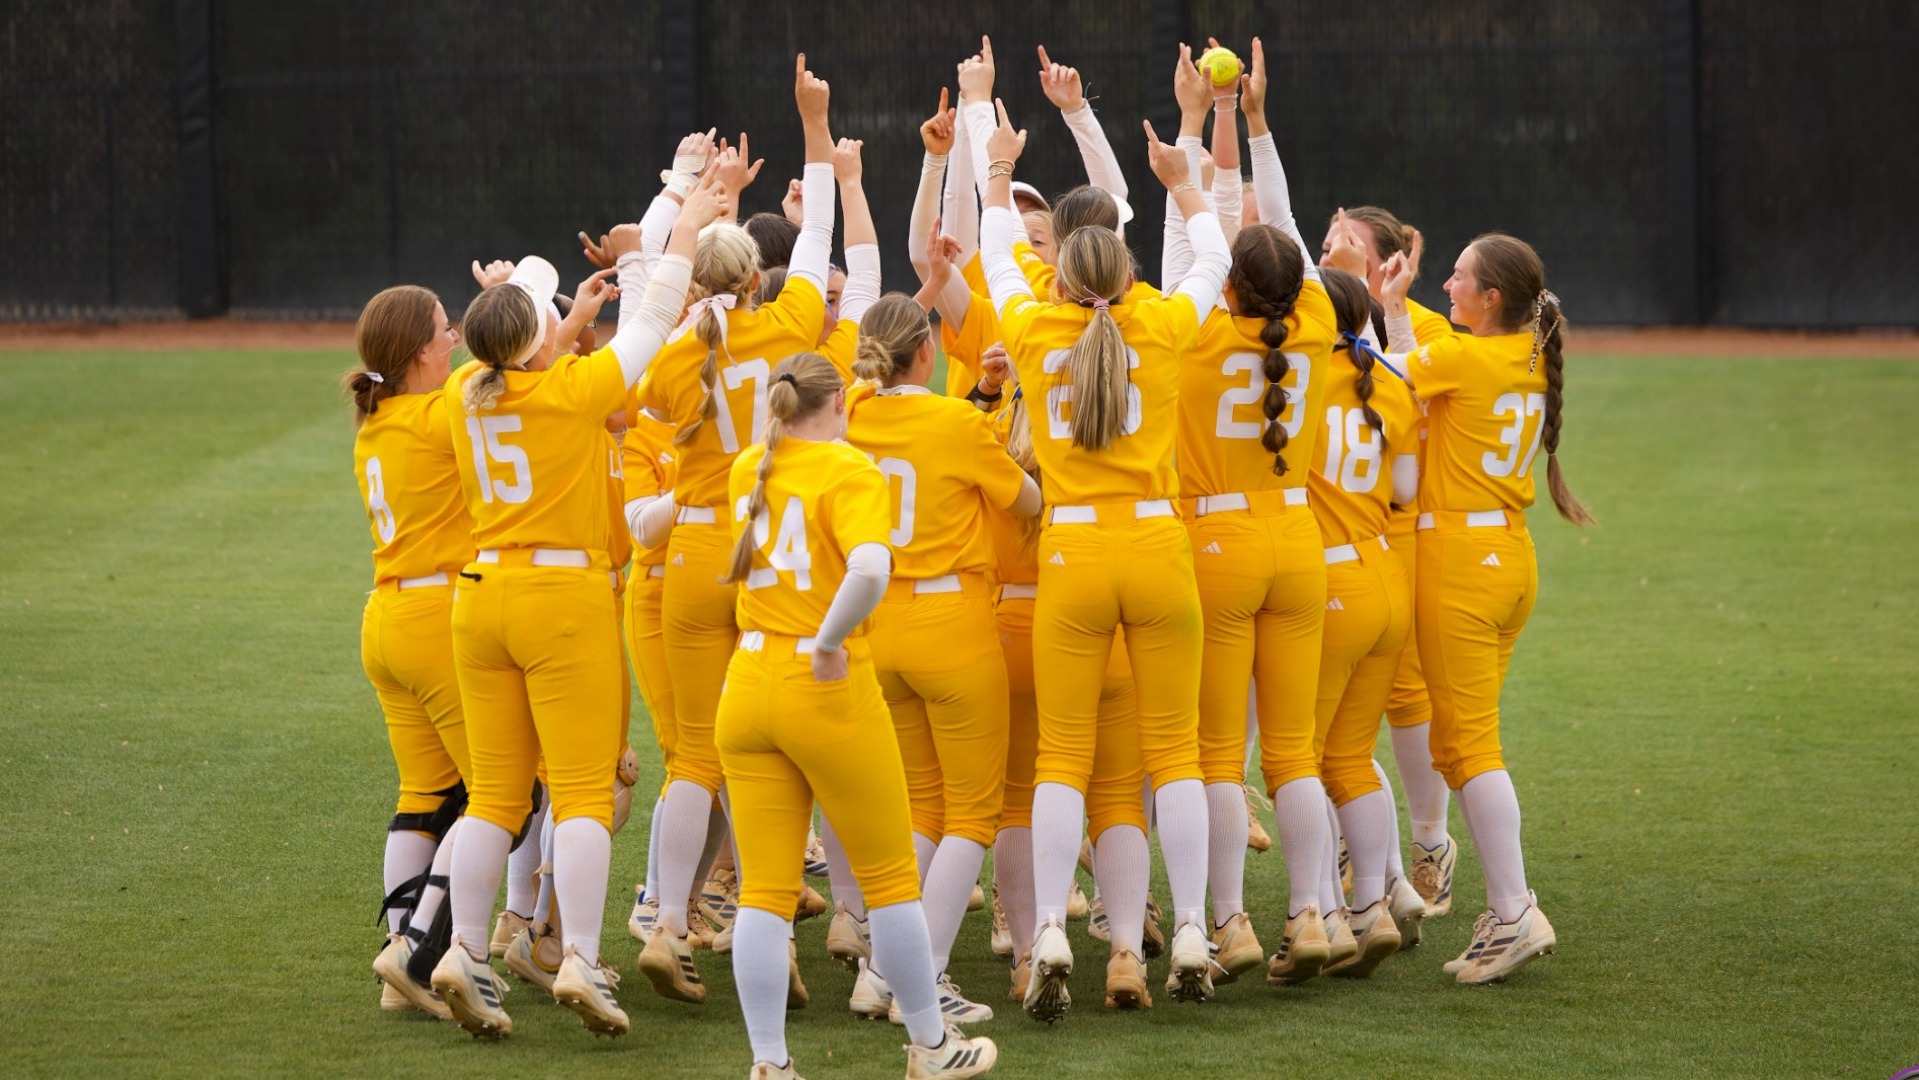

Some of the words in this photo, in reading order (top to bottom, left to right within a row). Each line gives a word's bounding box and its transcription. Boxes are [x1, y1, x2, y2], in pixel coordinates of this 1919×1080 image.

[700, 357, 770, 454] 17
[1215, 352, 1311, 439] 23
[1481, 392, 1546, 478] 37
[465, 414, 533, 504] 15
[1323, 405, 1386, 493] 18
[366, 455, 396, 544] 8
[735, 494, 812, 591] 24
[866, 452, 917, 548] 0
